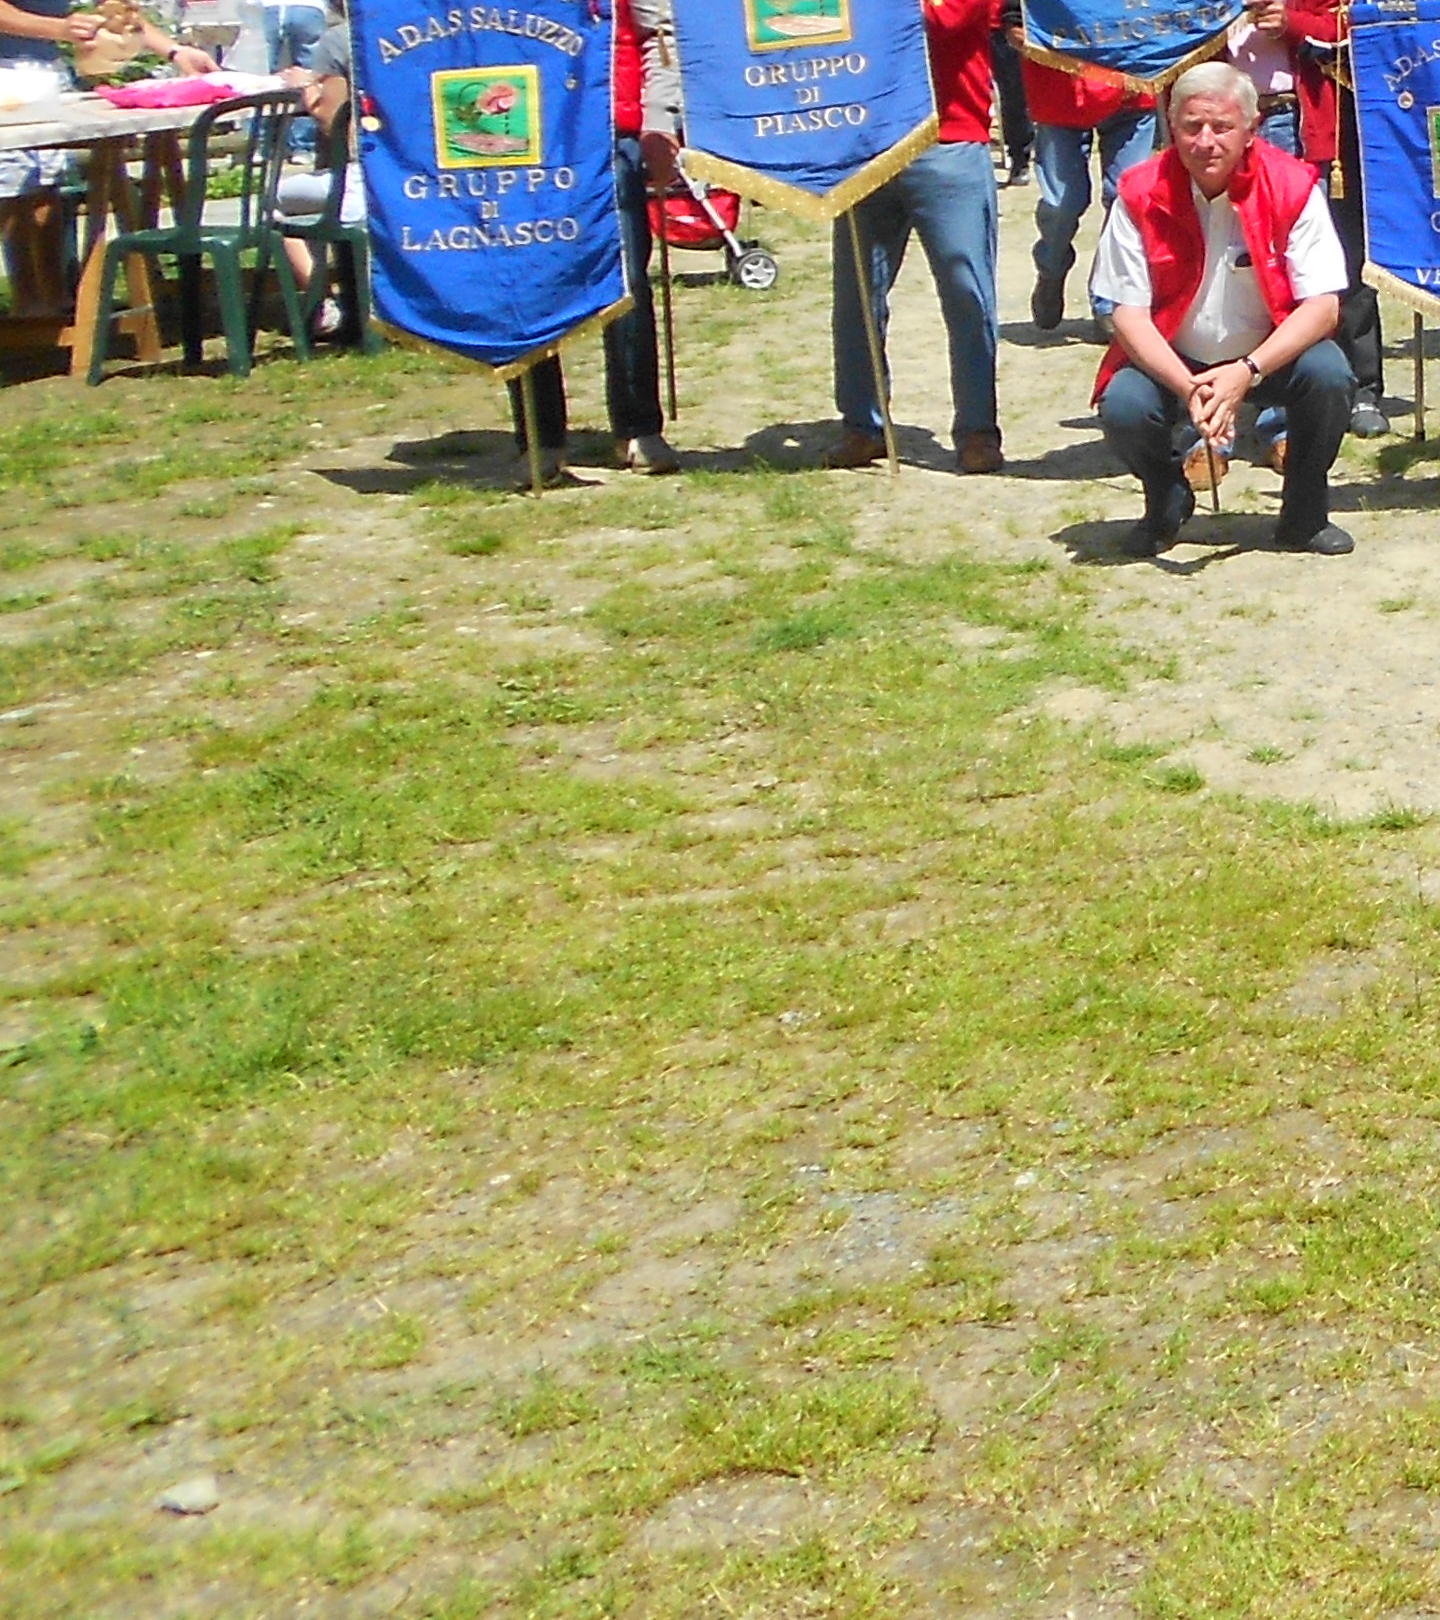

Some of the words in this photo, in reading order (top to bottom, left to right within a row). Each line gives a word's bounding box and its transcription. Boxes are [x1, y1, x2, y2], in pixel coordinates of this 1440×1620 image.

[469, 6, 585, 57] SALUZZO
[743, 52, 869, 88] GRUPPO
[795, 86, 823, 105] DI
[753, 104, 870, 138] PIASCO
[402, 166, 577, 201] GRUPPO
[479, 200, 500, 220] DI
[400, 216, 580, 252] LAGNASCO
